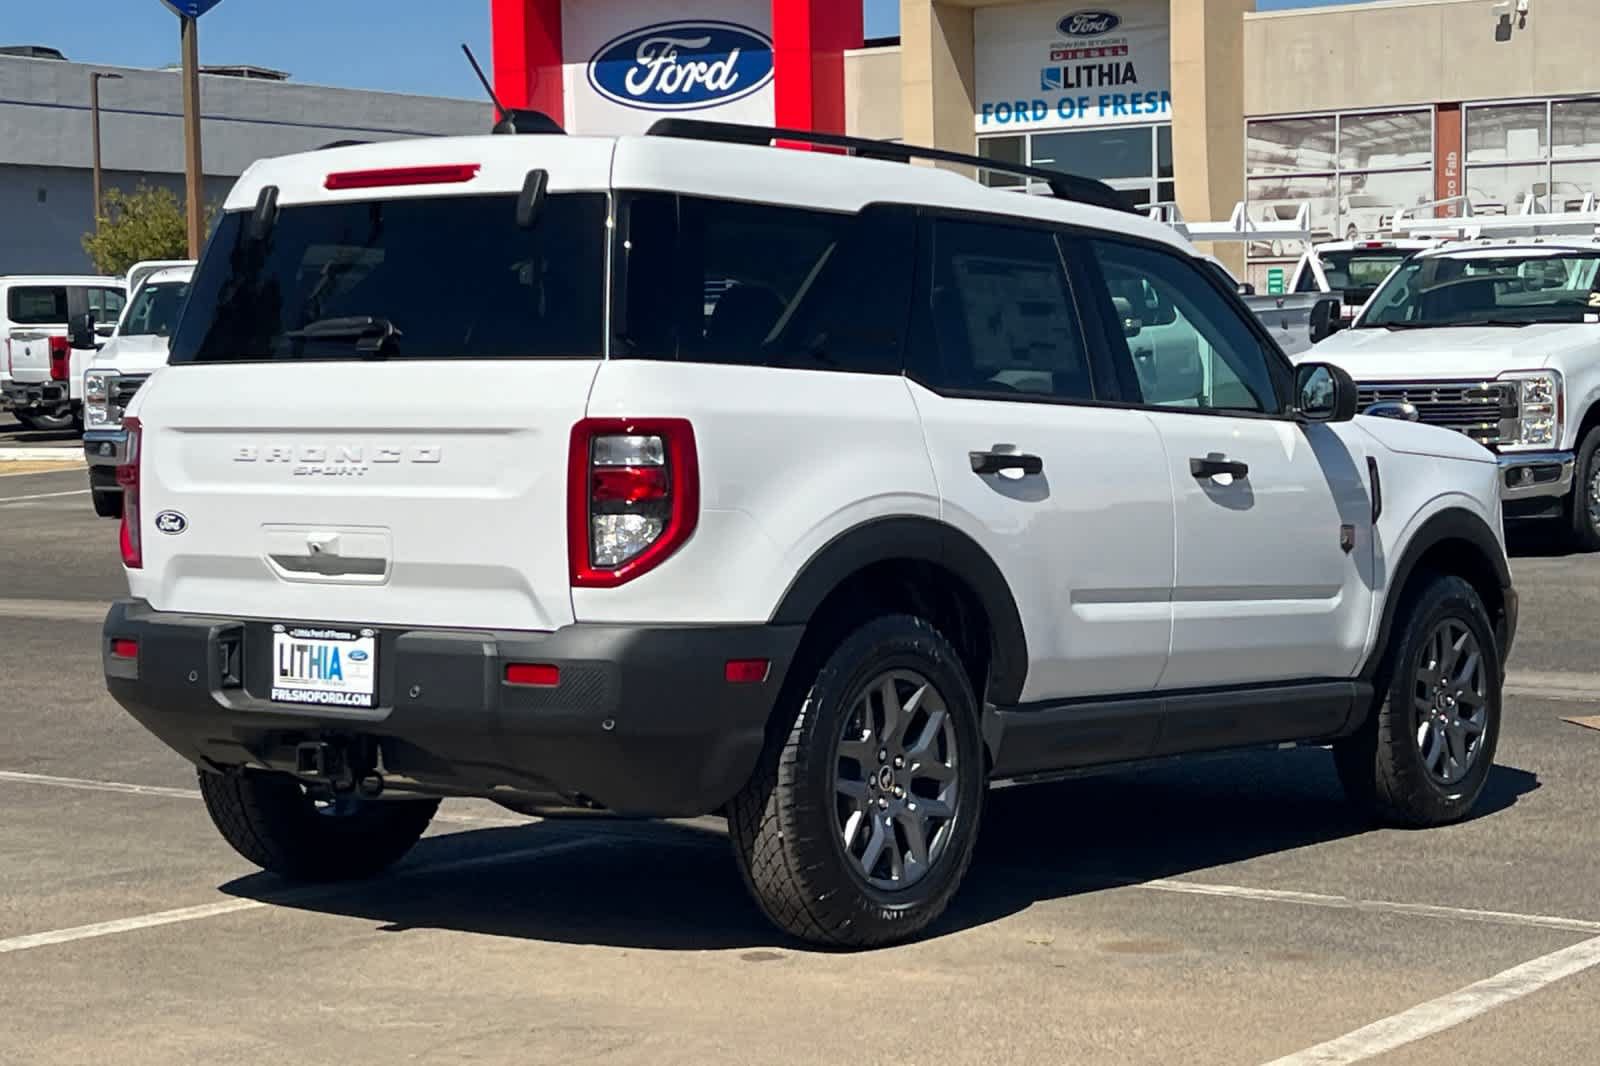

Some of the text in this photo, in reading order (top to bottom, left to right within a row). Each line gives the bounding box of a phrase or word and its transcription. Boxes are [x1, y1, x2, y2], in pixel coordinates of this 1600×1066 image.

[1069, 14, 1109, 32] Ford
[625, 36, 741, 95] Ford
[1063, 62, 1137, 89] LITHIA
[982, 100, 1048, 125] FORD
[1057, 96, 1090, 119] OF
[1445, 152, 1457, 176] Fab
[233, 446, 441, 464] BRONCO
[293, 466, 369, 475] SPORT
[279, 643, 343, 681] LITHIA
